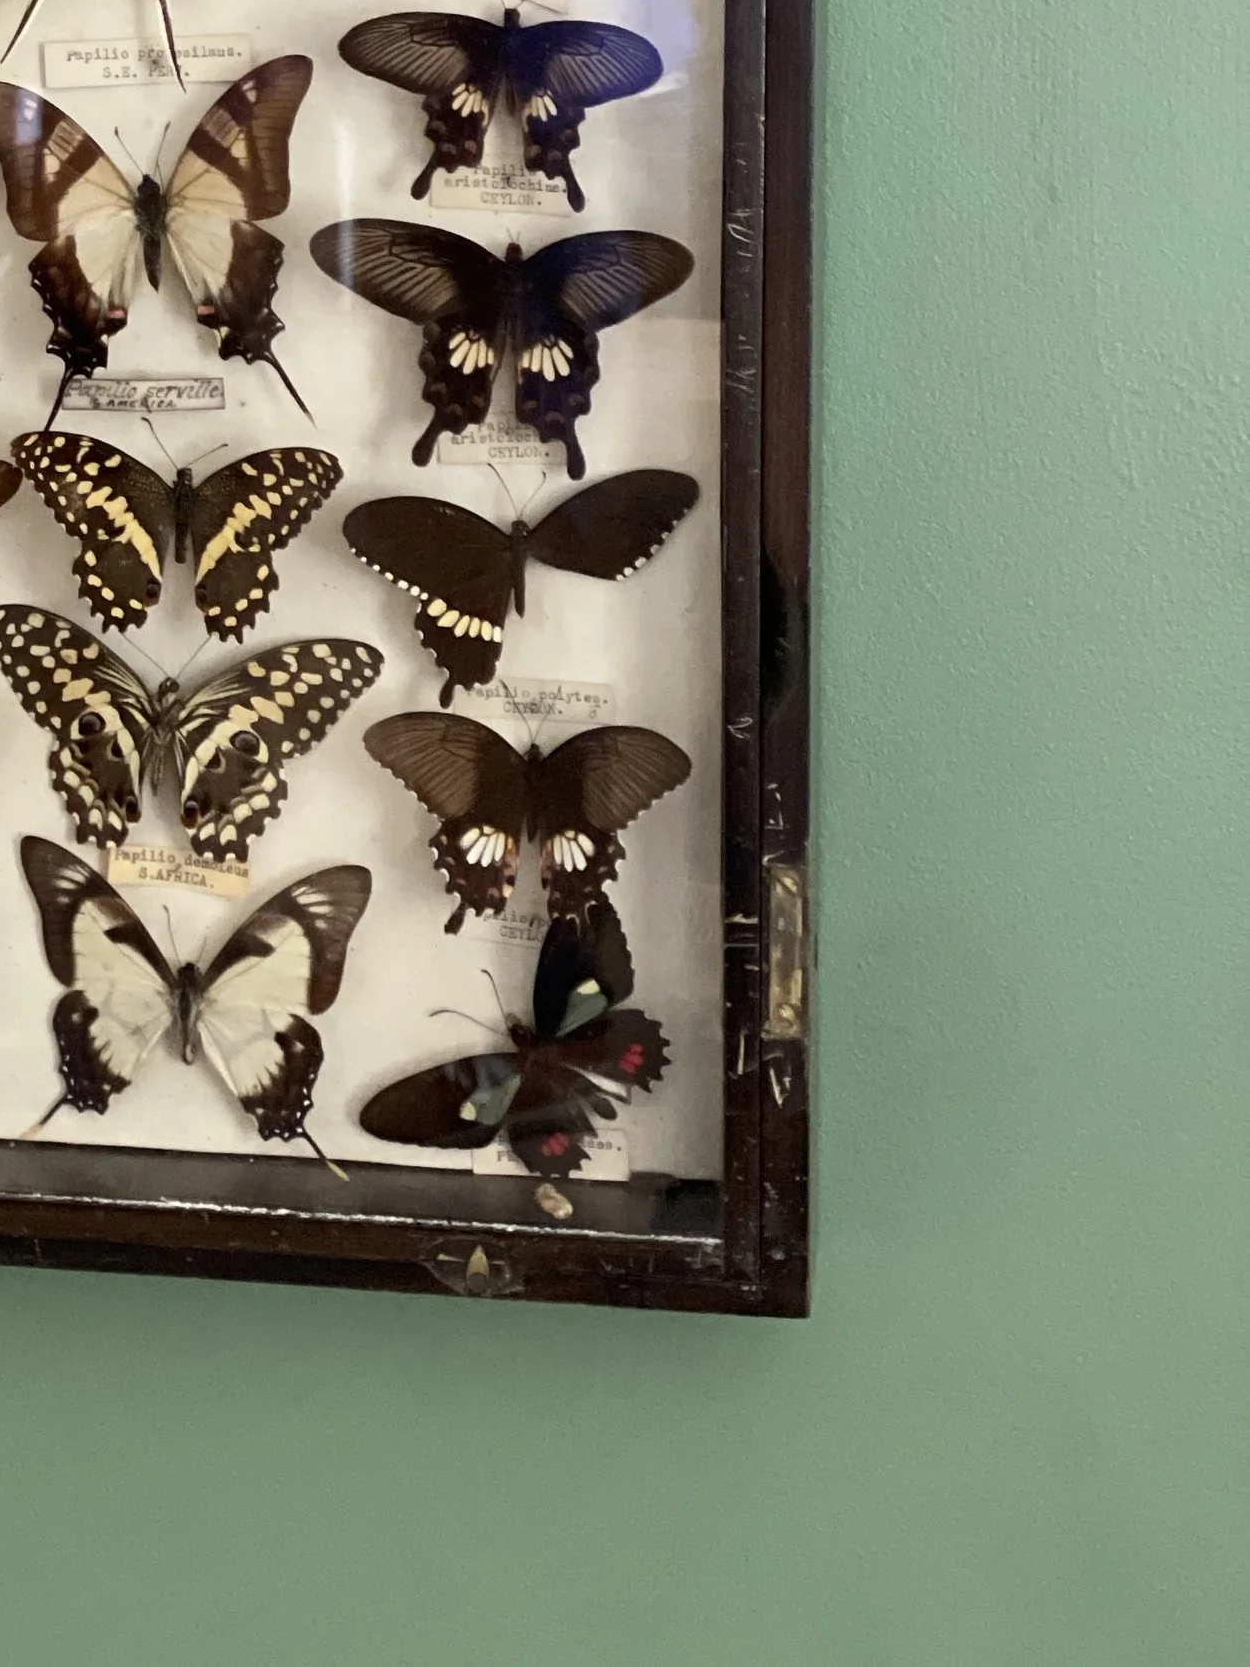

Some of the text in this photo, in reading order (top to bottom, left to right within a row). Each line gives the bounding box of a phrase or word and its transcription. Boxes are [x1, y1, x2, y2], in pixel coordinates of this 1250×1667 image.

[137, 46, 243, 62] proesilaus.
[480, 190, 542, 206] CEYLON.
[488, 445, 550, 458] CEYLON.
[538, 691, 609, 706] polytes.
[114, 848, 177, 865] Papilio
[500, 925, 544, 942] CEYLO
